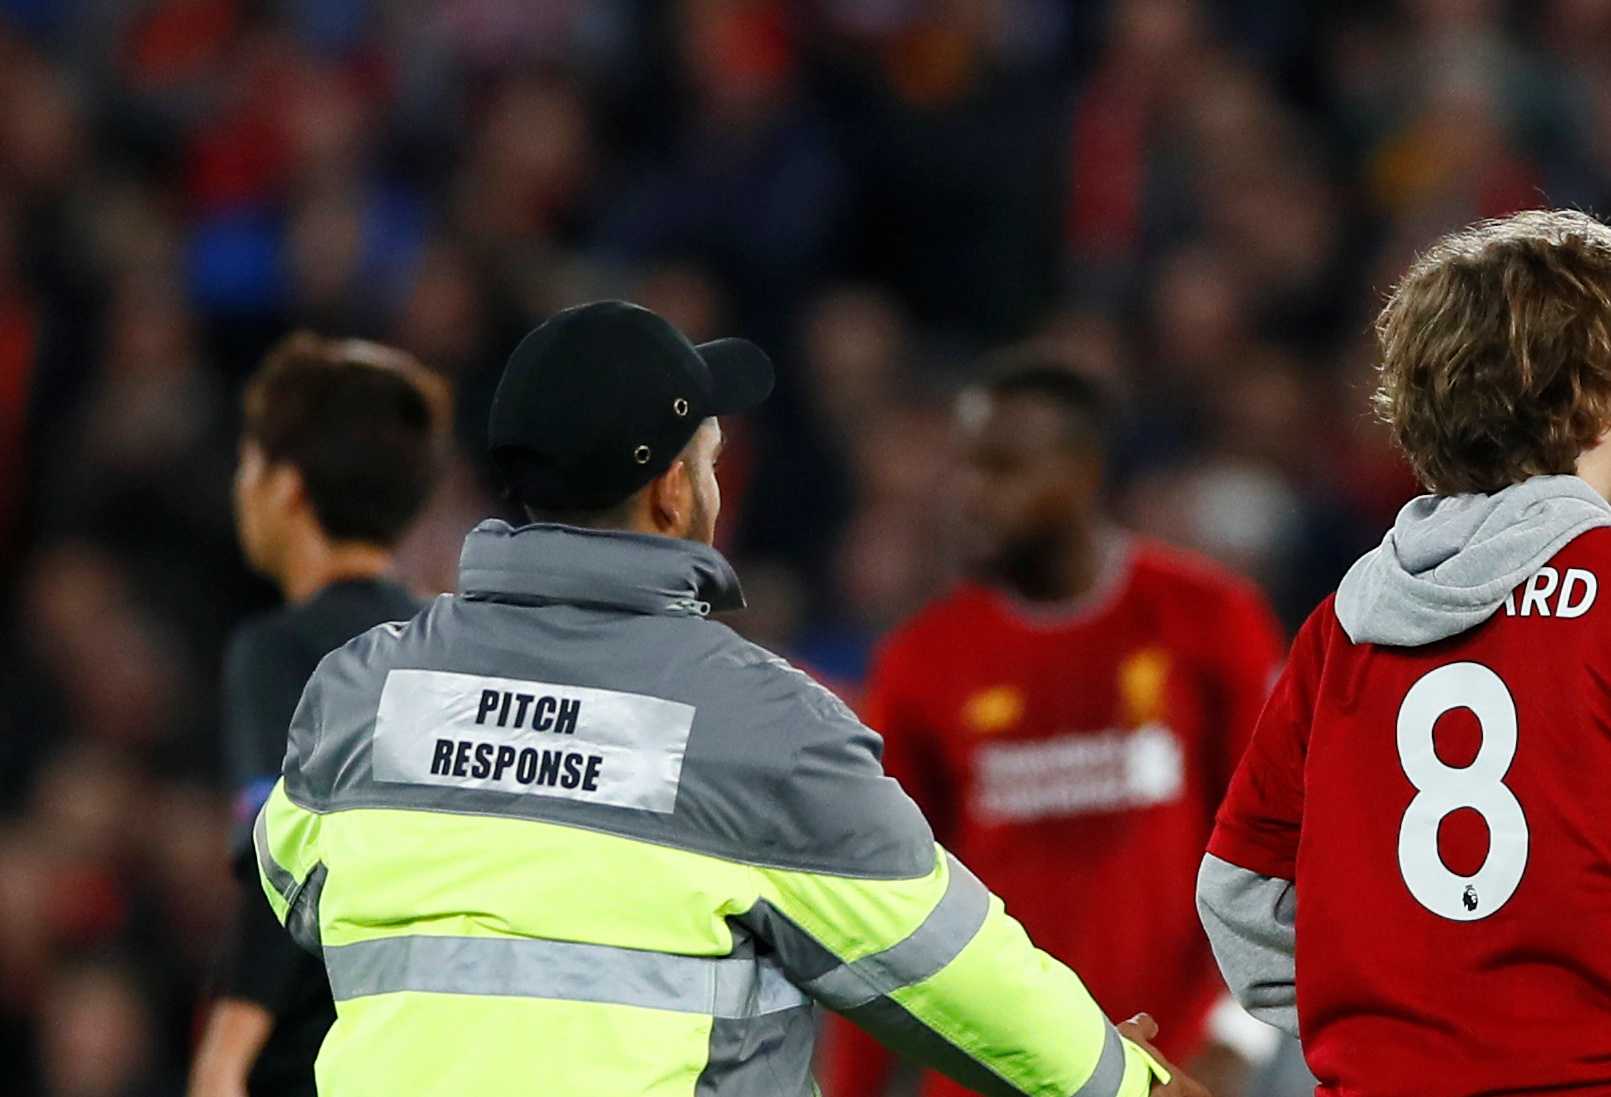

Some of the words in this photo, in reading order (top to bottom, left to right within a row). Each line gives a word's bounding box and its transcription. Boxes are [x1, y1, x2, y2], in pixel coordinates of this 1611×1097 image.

[475, 689, 581, 735] PITCH
[430, 739, 603, 792] RESPONSE
[1396, 660, 1530, 921] 8
